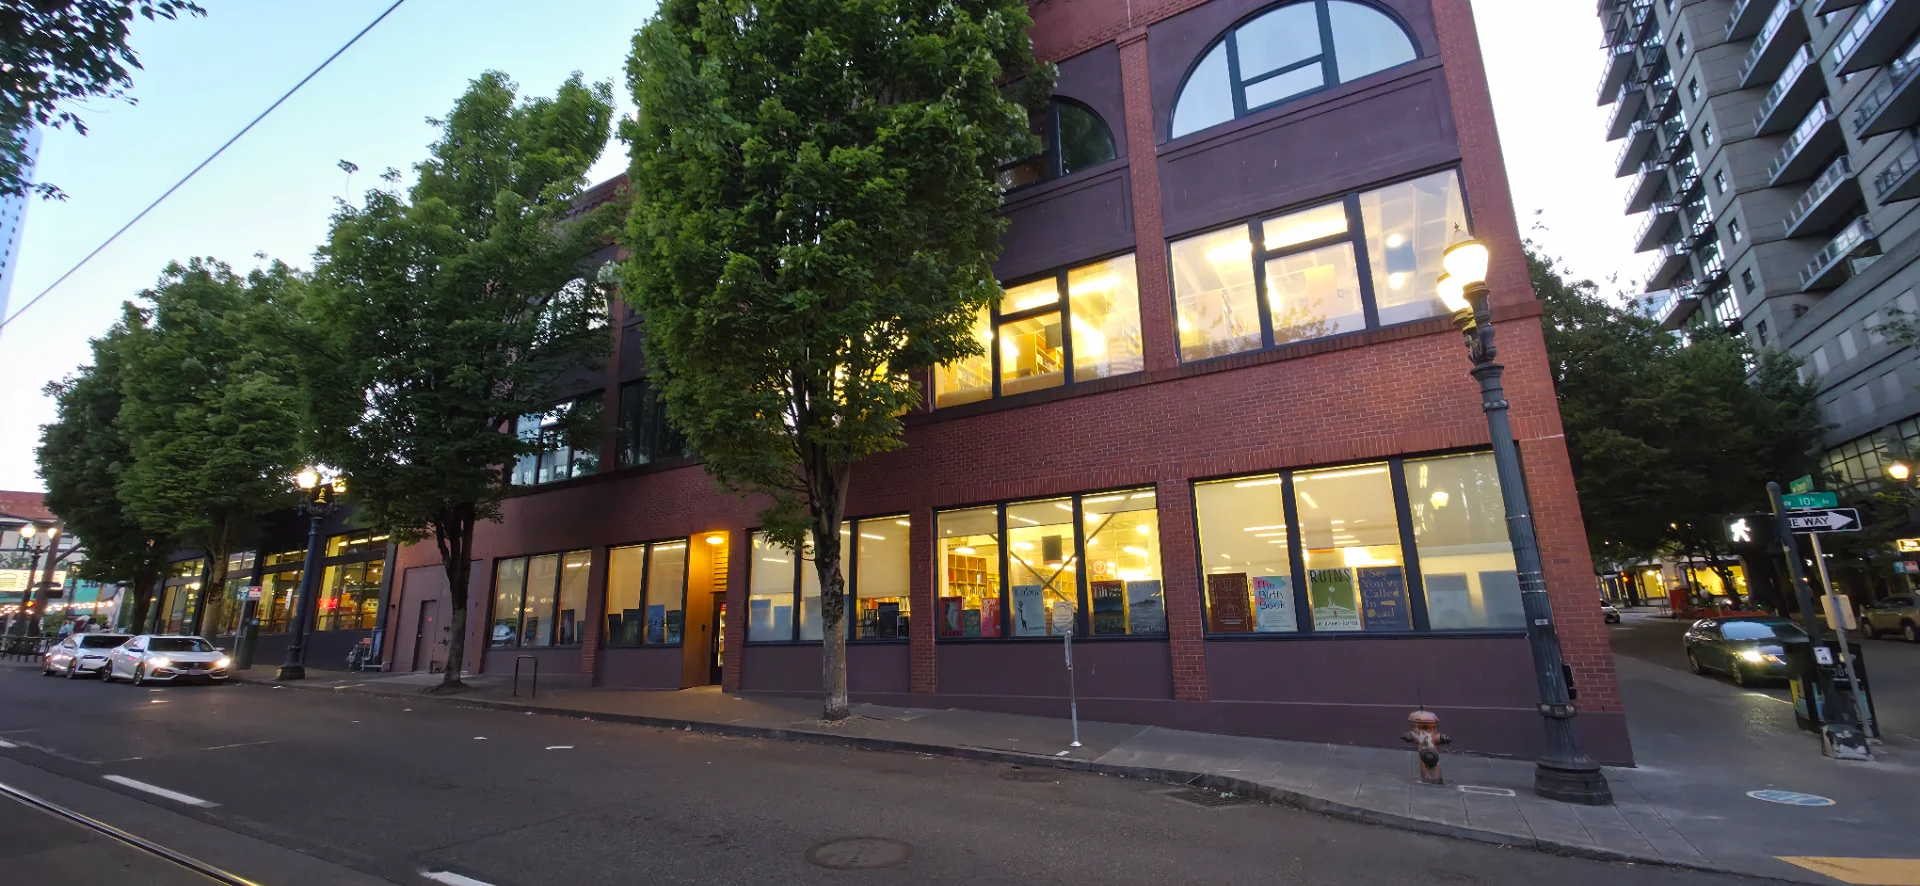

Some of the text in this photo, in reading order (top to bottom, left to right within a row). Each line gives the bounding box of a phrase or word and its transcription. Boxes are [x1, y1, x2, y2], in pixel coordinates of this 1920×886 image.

[1803, 517, 1828, 526] WAY
[1310, 568, 1351, 583] RUINS
[1257, 580, 1275, 590] The
[1259, 590, 1284, 600] Birth
[1363, 587, 1400, 598] Called
[1260, 600, 1287, 610] Book
